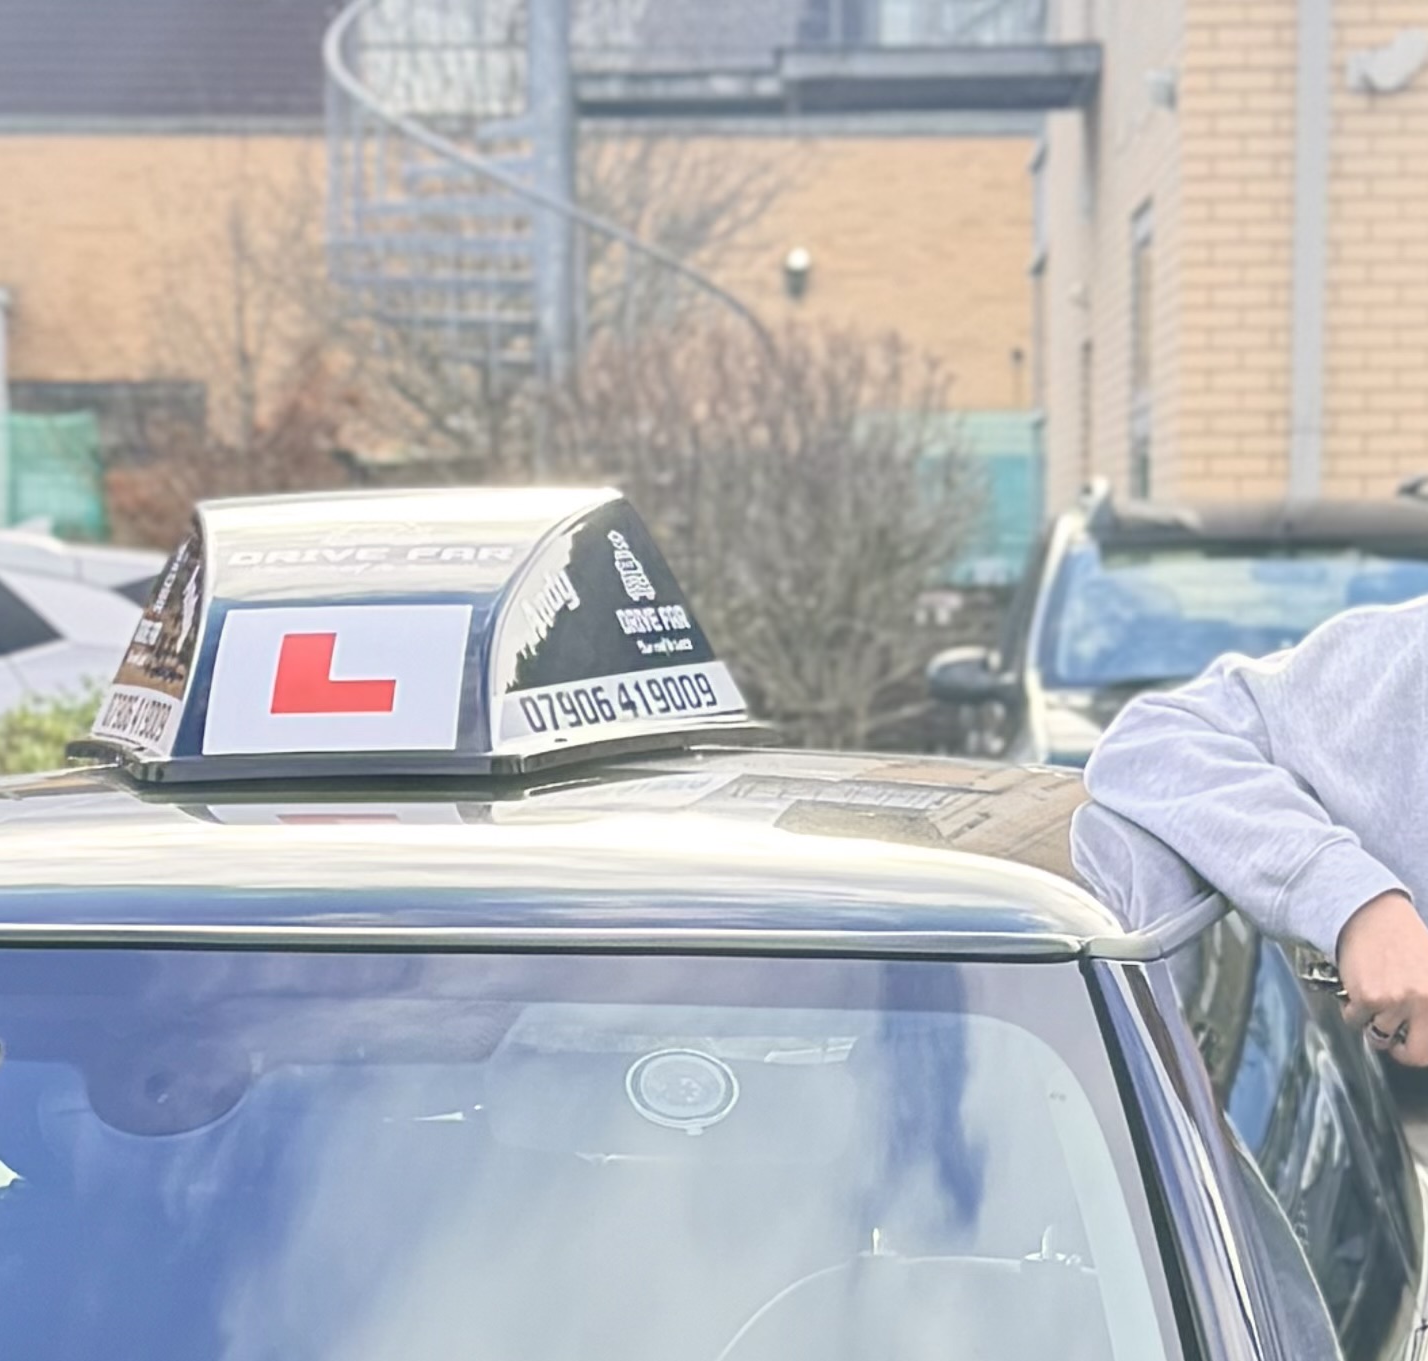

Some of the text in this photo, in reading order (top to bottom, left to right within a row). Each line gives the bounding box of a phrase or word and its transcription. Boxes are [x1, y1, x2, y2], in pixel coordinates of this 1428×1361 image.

[227, 546, 391, 567] DRIVE
[615, 607, 664, 635] DRIVE
[271, 632, 396, 714] L
[522, 673, 717, 732] 07906 419009
